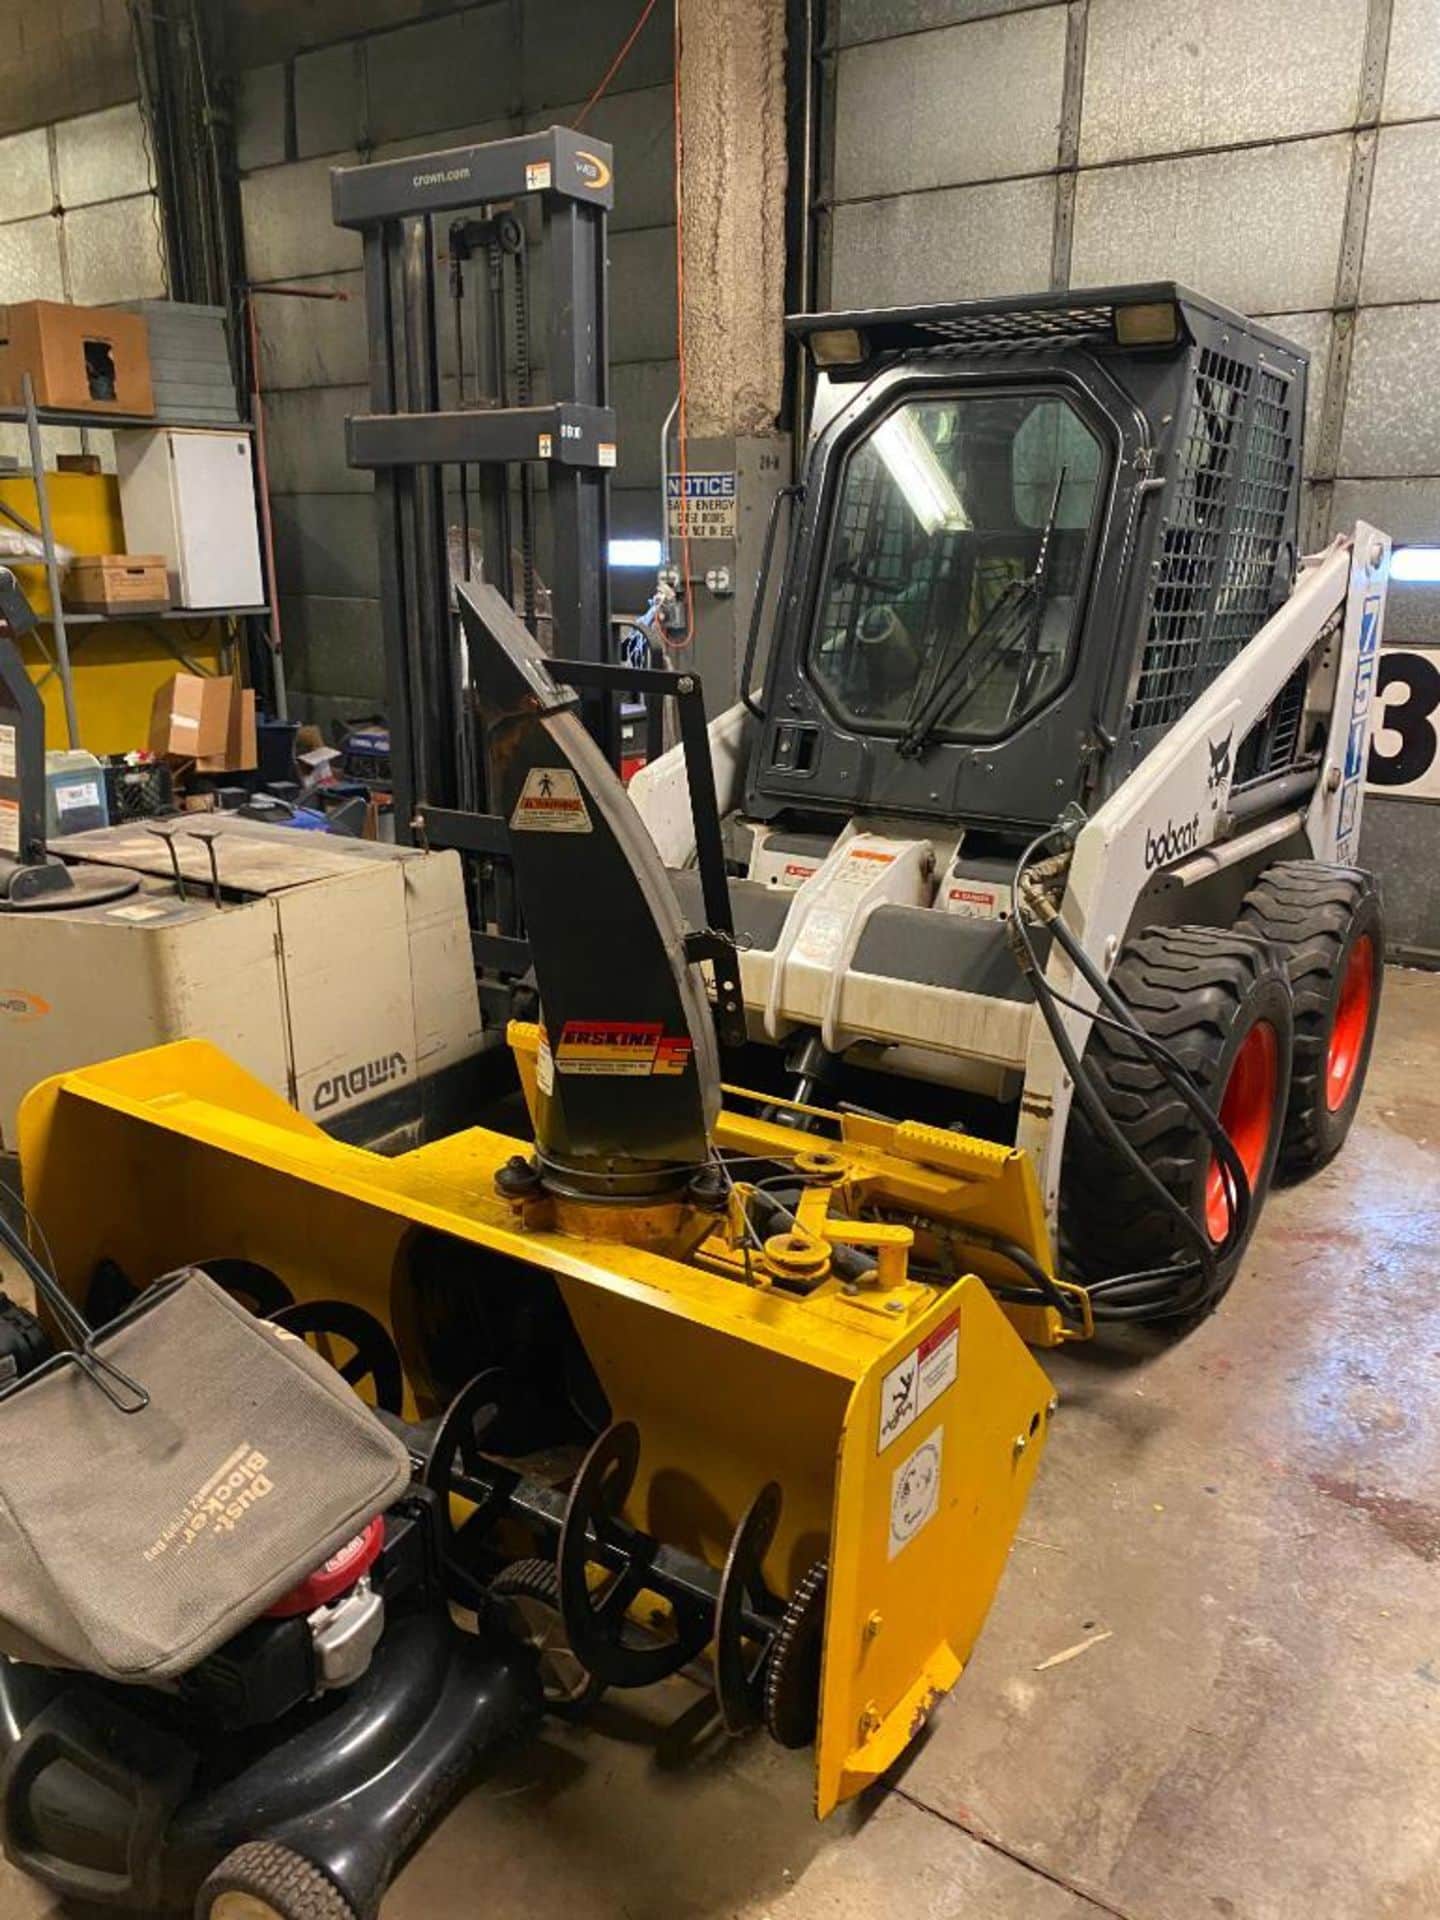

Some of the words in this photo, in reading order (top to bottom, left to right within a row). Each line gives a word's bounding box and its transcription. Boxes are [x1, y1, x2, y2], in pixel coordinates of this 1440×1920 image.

[412, 167, 472, 188] crown.com
[667, 477, 734, 495] NOTICE
[667, 499, 691, 511] SAE
[696, 499, 734, 511] ENERGY
[1365, 652, 1440, 786] 3
[1144, 812, 1199, 870] bobcat
[561, 1031, 660, 1046] ERSKINE
[313, 1051, 407, 1111] CROWN
